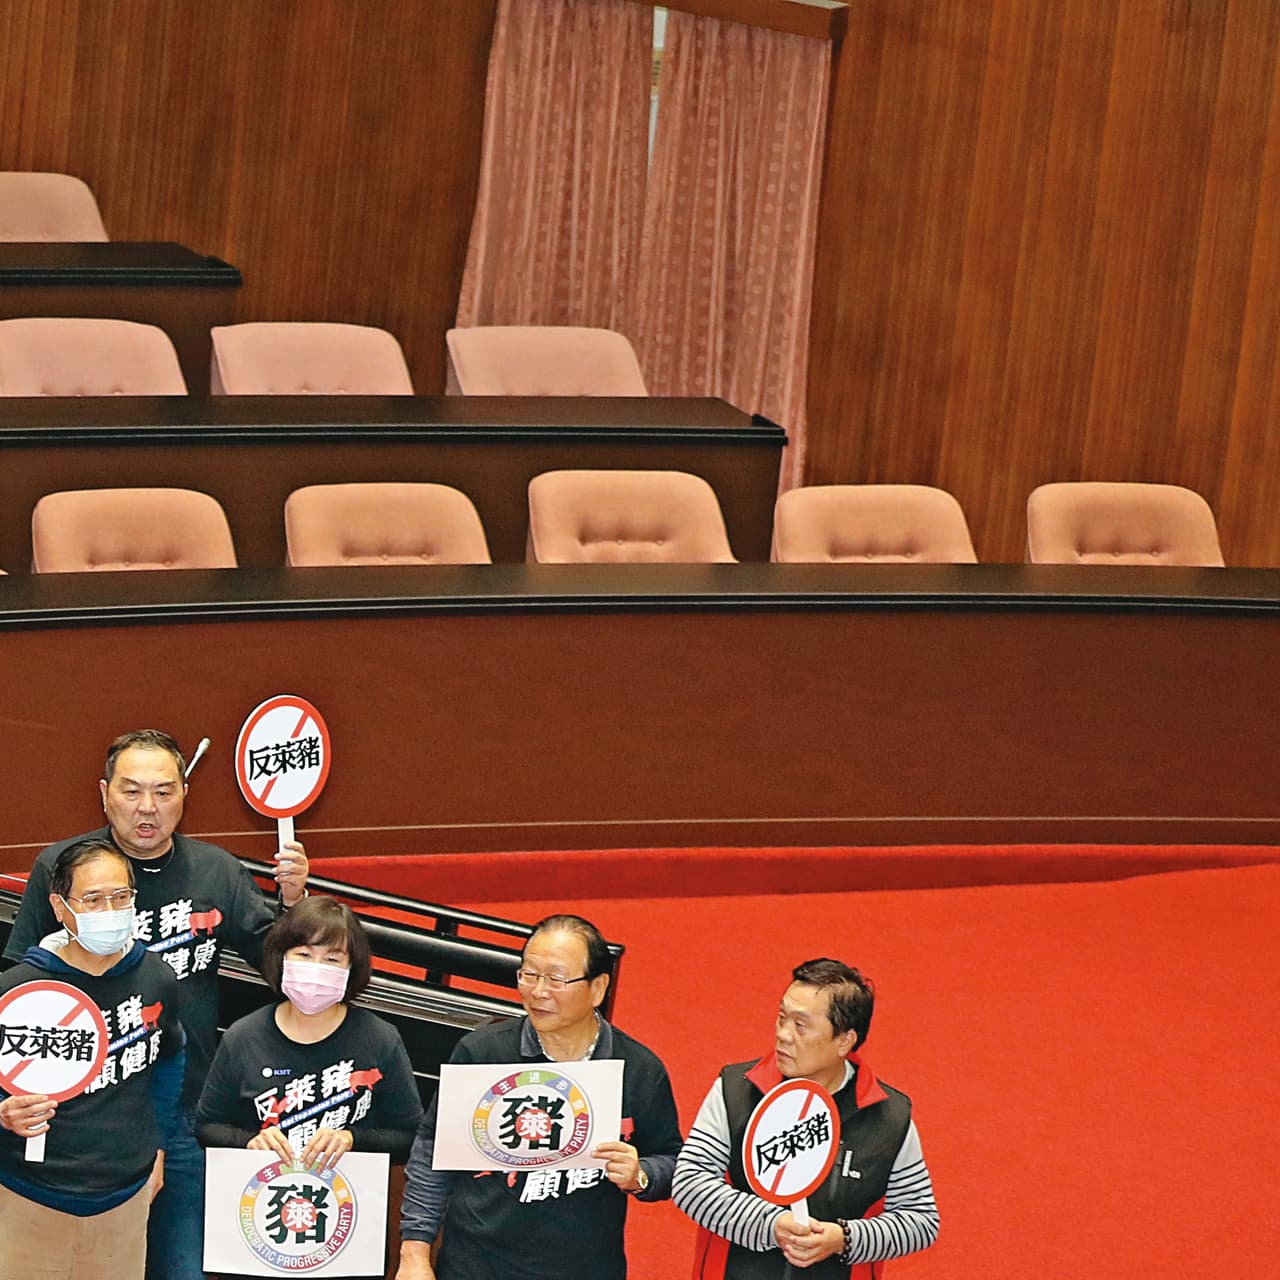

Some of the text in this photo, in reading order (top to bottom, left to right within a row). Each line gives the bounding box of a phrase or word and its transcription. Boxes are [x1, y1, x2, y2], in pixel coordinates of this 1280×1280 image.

[249, 737, 320, 780] 反萊豬
[132, 899, 193, 942] 萊豬
[161, 938, 217, 980] 健康
[254, 1060, 354, 1121] 反萊豬
[571, 1118, 587, 1147] PARTY
[756, 1111, 830, 1176] 反萊豬
[519, 1168, 609, 1203] 顧健
[241, 1206, 352, 1268] DEMOCRATIC PROGRESSIVE PARTY
